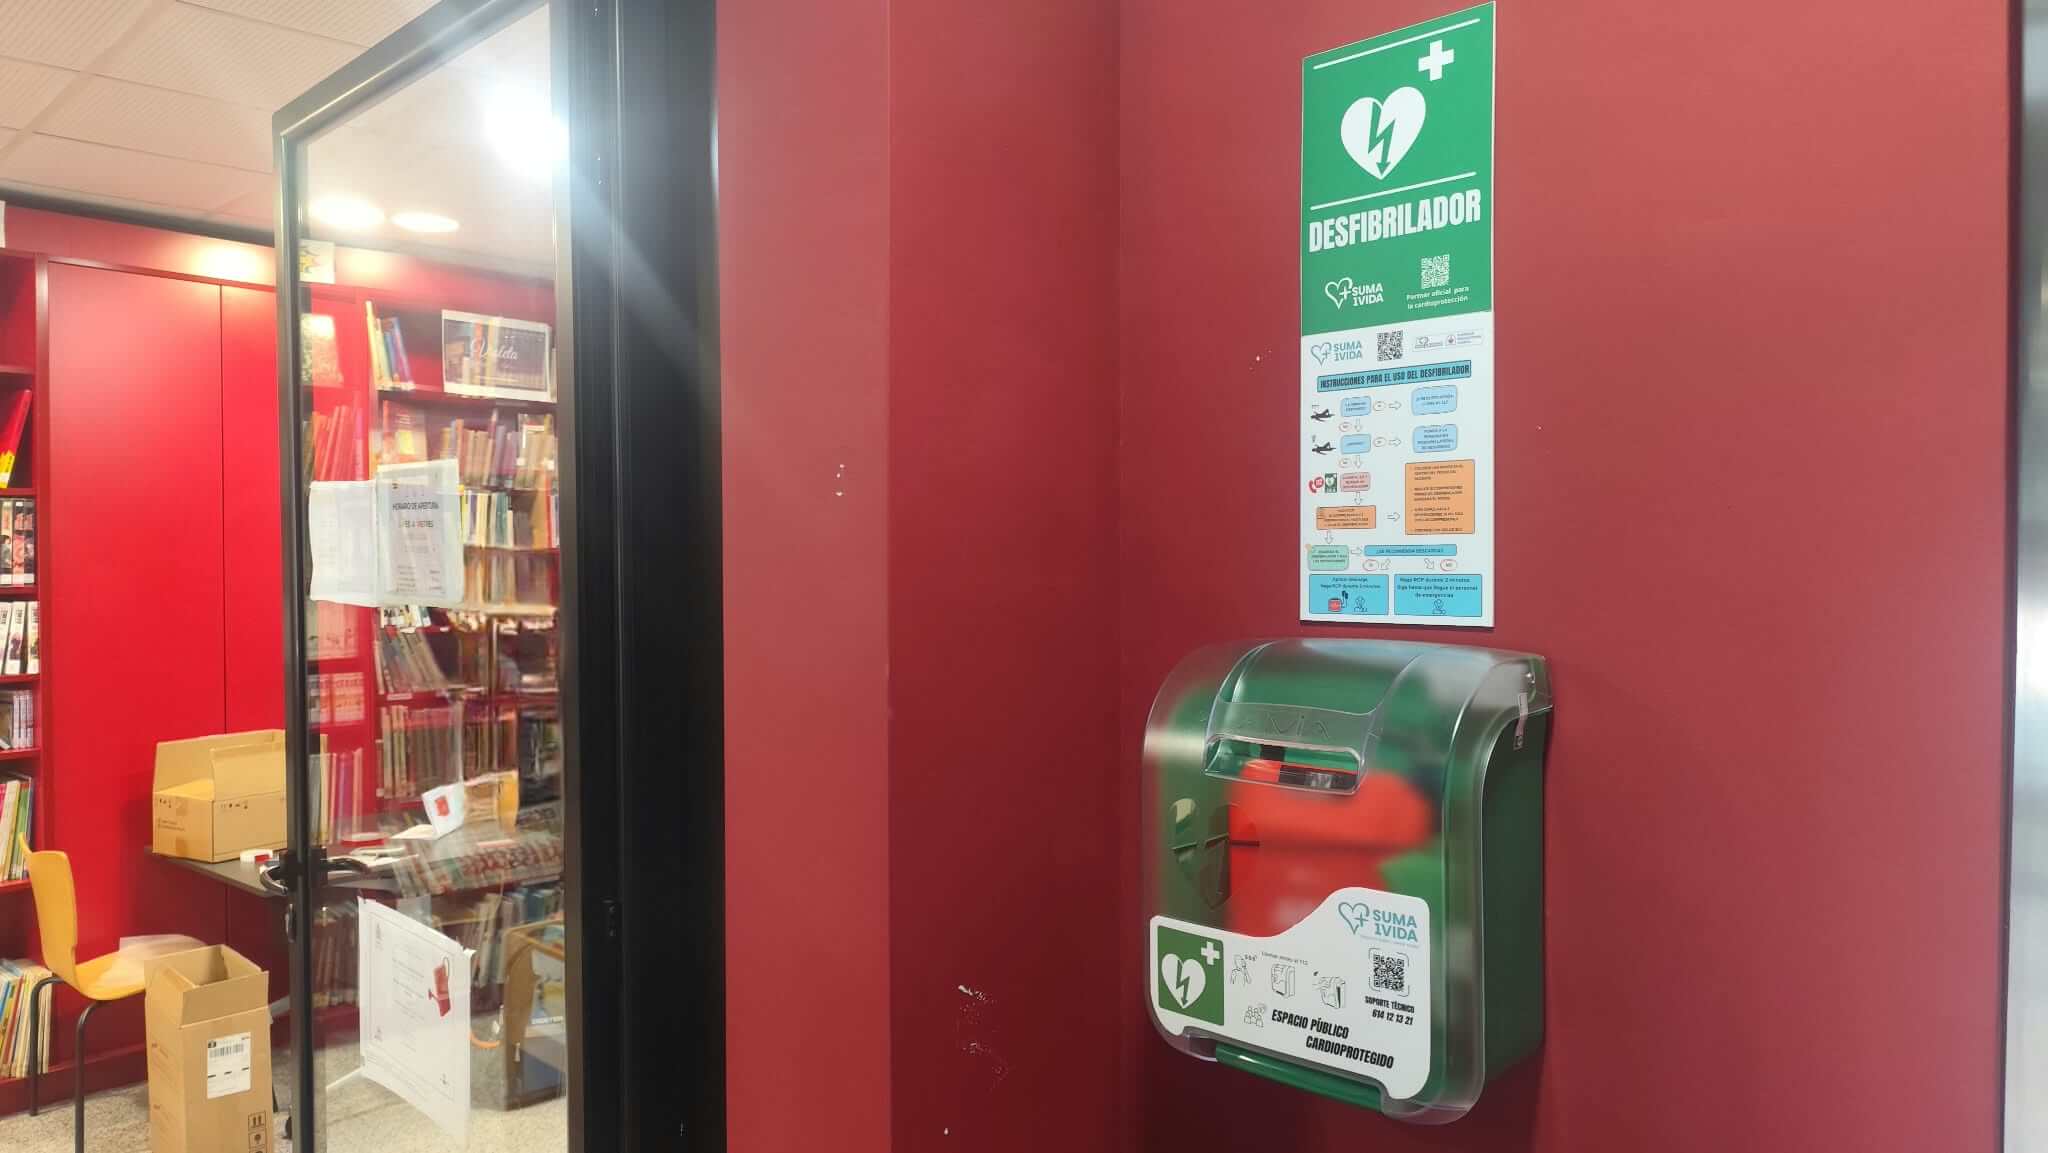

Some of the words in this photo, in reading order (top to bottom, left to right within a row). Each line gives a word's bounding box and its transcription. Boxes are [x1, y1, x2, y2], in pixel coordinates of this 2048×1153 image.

[1309, 189, 1481, 253] DESFIBRILADOR
[1352, 283, 1383, 297] SUMA
[1431, 288, 1451, 297] oficial
[1454, 285, 1469, 295] para
[1353, 295, 1384, 307] 1VIDA
[1333, 341, 1362, 352] SUMA
[1334, 350, 1363, 361] 1VIDA
[1320, 375, 1365, 389] INSTRUCCIONES
[1366, 374, 1383, 384] PARA
[1384, 373, 1392, 383] EL
[1393, 371, 1405, 381] USO
[1407, 369, 1419, 380] DEL
[1420, 364, 1470, 378] DESFIBRILADOR
[1372, 909, 1417, 929] SUMA
[1374, 923, 1418, 942] 1VIDA
[1364, 995, 1390, 1009] SOPORTE
[1391, 1000, 1415, 1014] TÉCNICO
[1271, 1009, 1309, 1029] ESPACIO
[1310, 1017, 1350, 1040] PÚBLICO
[1372, 1009, 1385, 1020] 614
[1386, 1011, 1394, 1022] 12
[1395, 1014, 1404, 1024] 13
[1404, 1015, 1414, 1026] 21
[1305, 1035, 1395, 1069] CARDIOPROTEGIDO
